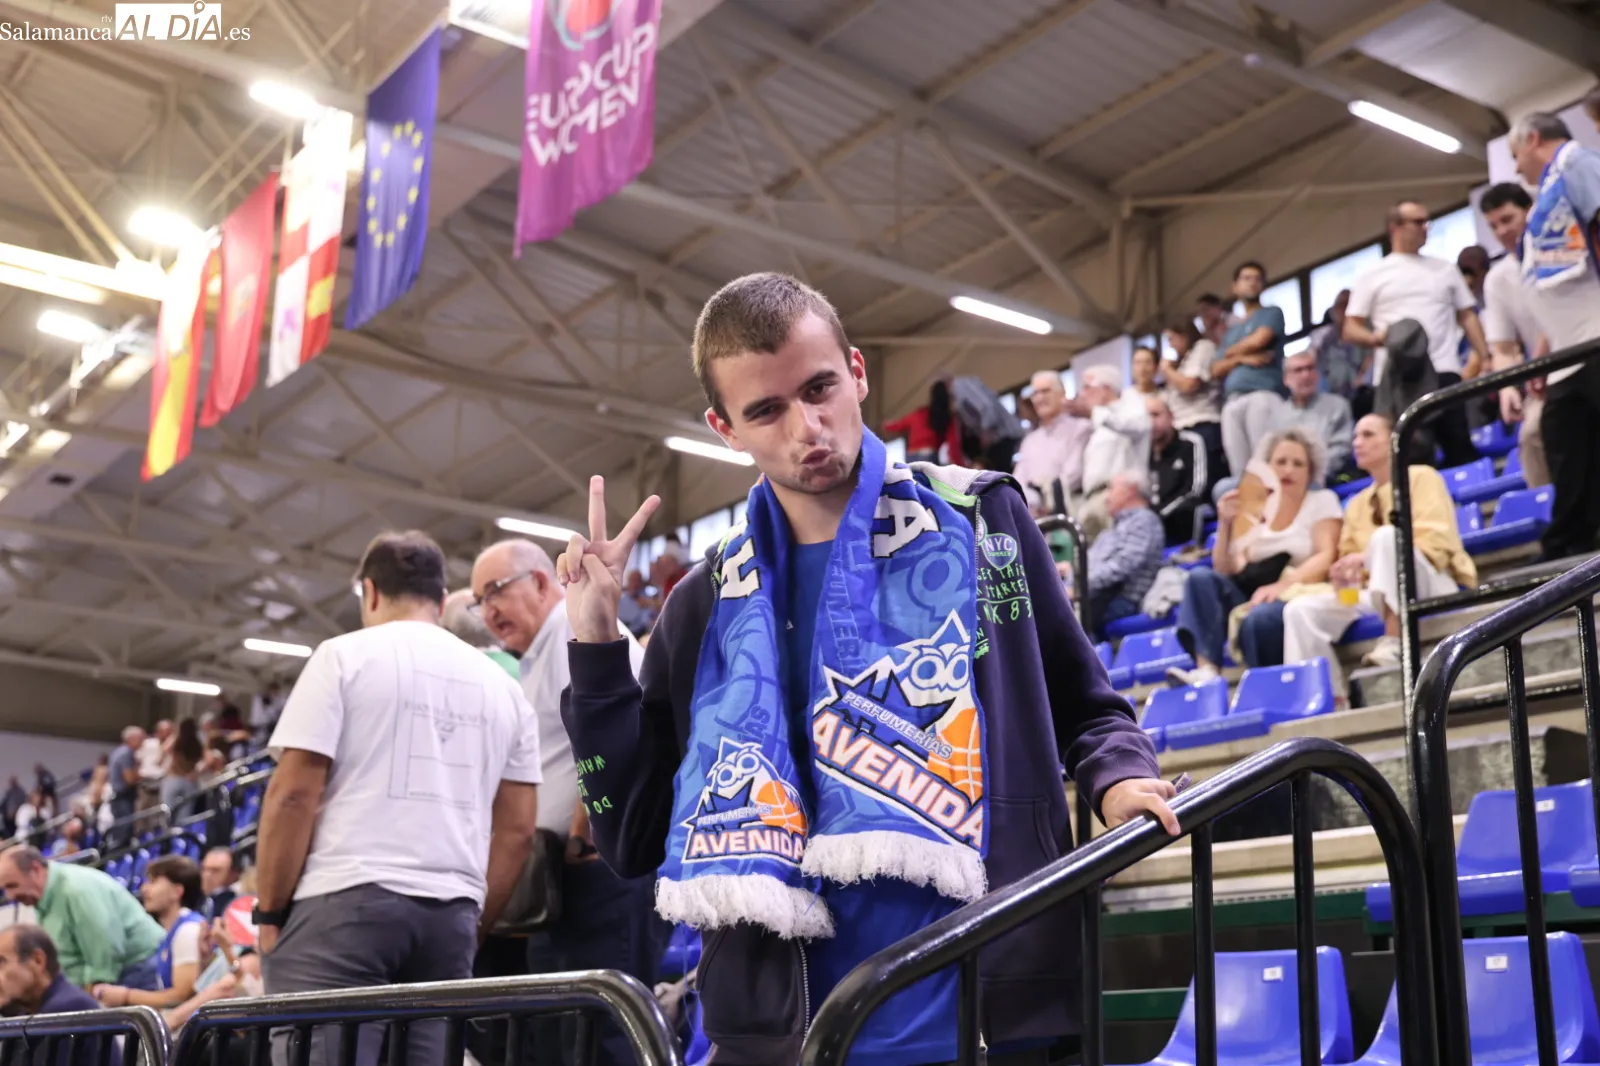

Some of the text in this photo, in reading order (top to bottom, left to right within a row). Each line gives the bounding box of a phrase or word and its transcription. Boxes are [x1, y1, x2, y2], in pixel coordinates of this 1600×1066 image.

[984, 536, 1013, 552] NYC
[812, 709, 984, 849] AVENIDA
[688, 829, 805, 860] AVENIDA
